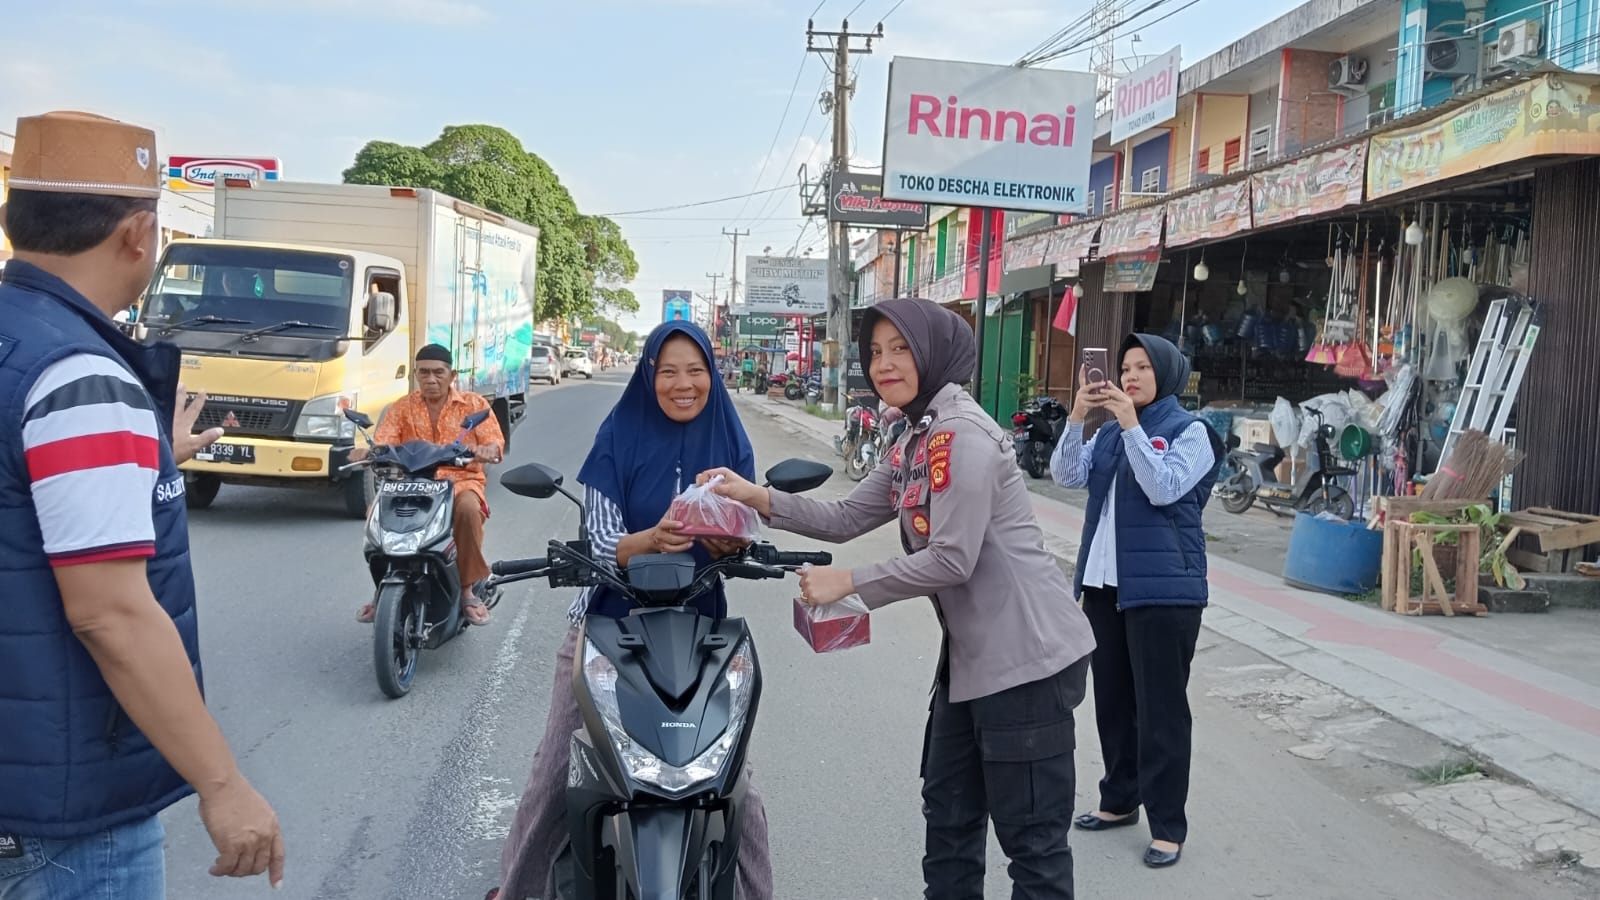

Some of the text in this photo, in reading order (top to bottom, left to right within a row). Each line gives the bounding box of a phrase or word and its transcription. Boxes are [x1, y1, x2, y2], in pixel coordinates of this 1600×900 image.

[1116, 55, 1174, 121] Rinnai
[907, 93, 1077, 147] Rinnai
[899, 174, 1076, 202] TOKO DESCHA ELEKTRONIK
[252, 398, 289, 406] FUSO
[210, 443, 234, 456] 8339
[240, 446, 252, 458] YL
[397, 482, 425, 492] 6775
